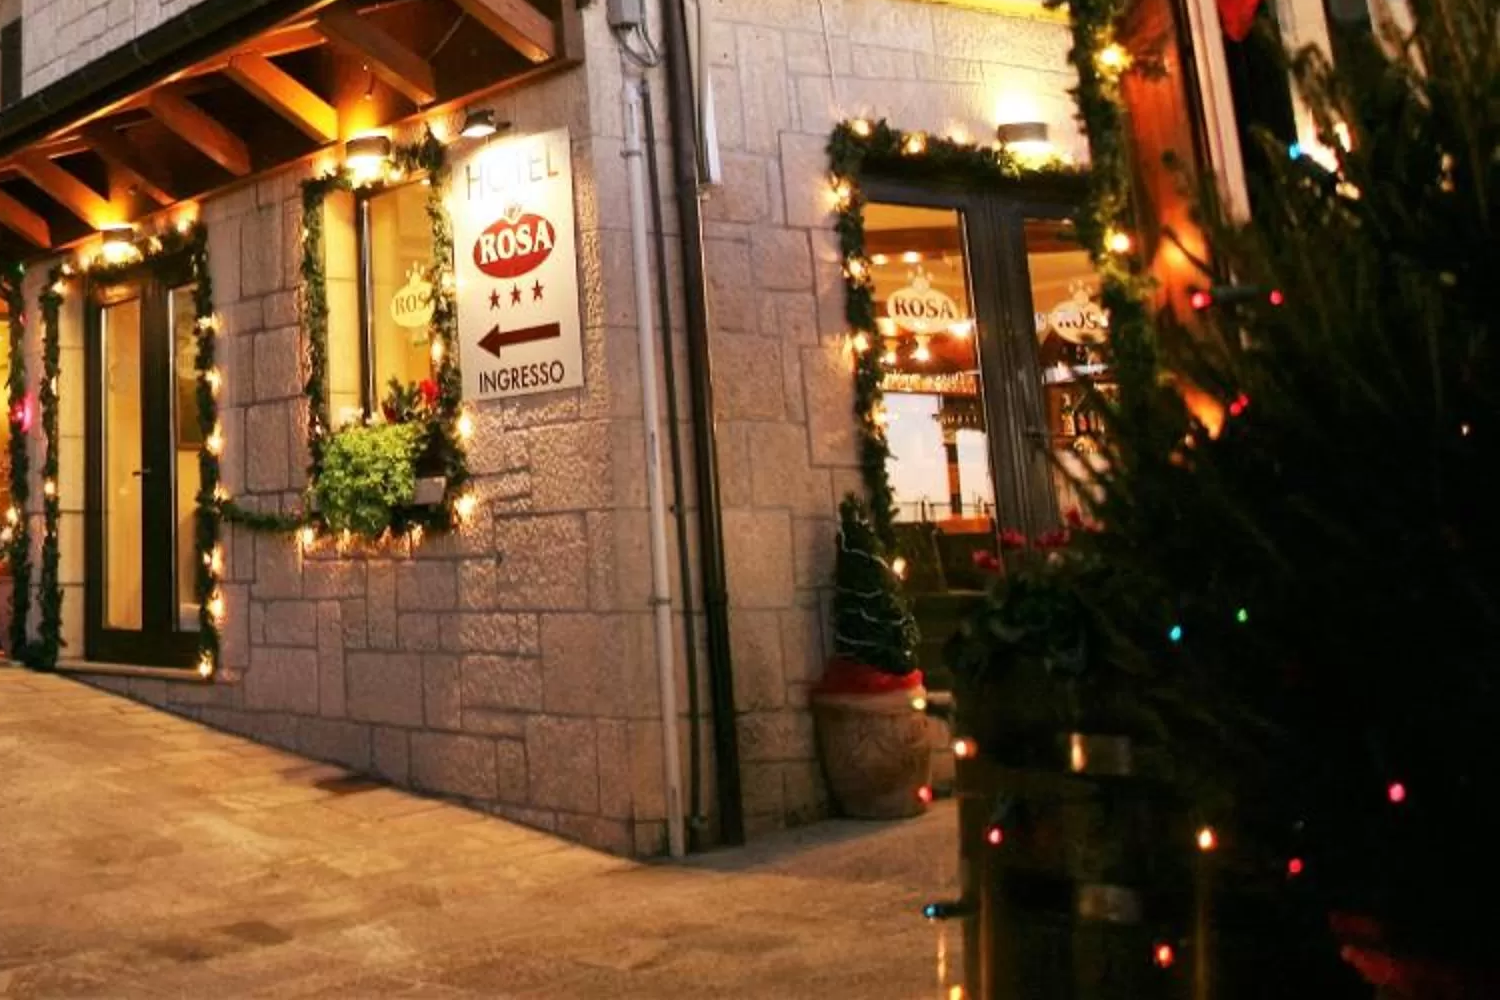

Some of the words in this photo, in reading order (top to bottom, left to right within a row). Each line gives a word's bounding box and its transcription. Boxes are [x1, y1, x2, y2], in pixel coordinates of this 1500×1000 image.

[479, 219, 553, 265] ROSA
[395, 290, 432, 316] ROS
[894, 295, 955, 319] ROSA
[479, 359, 565, 393] INGRESSO
